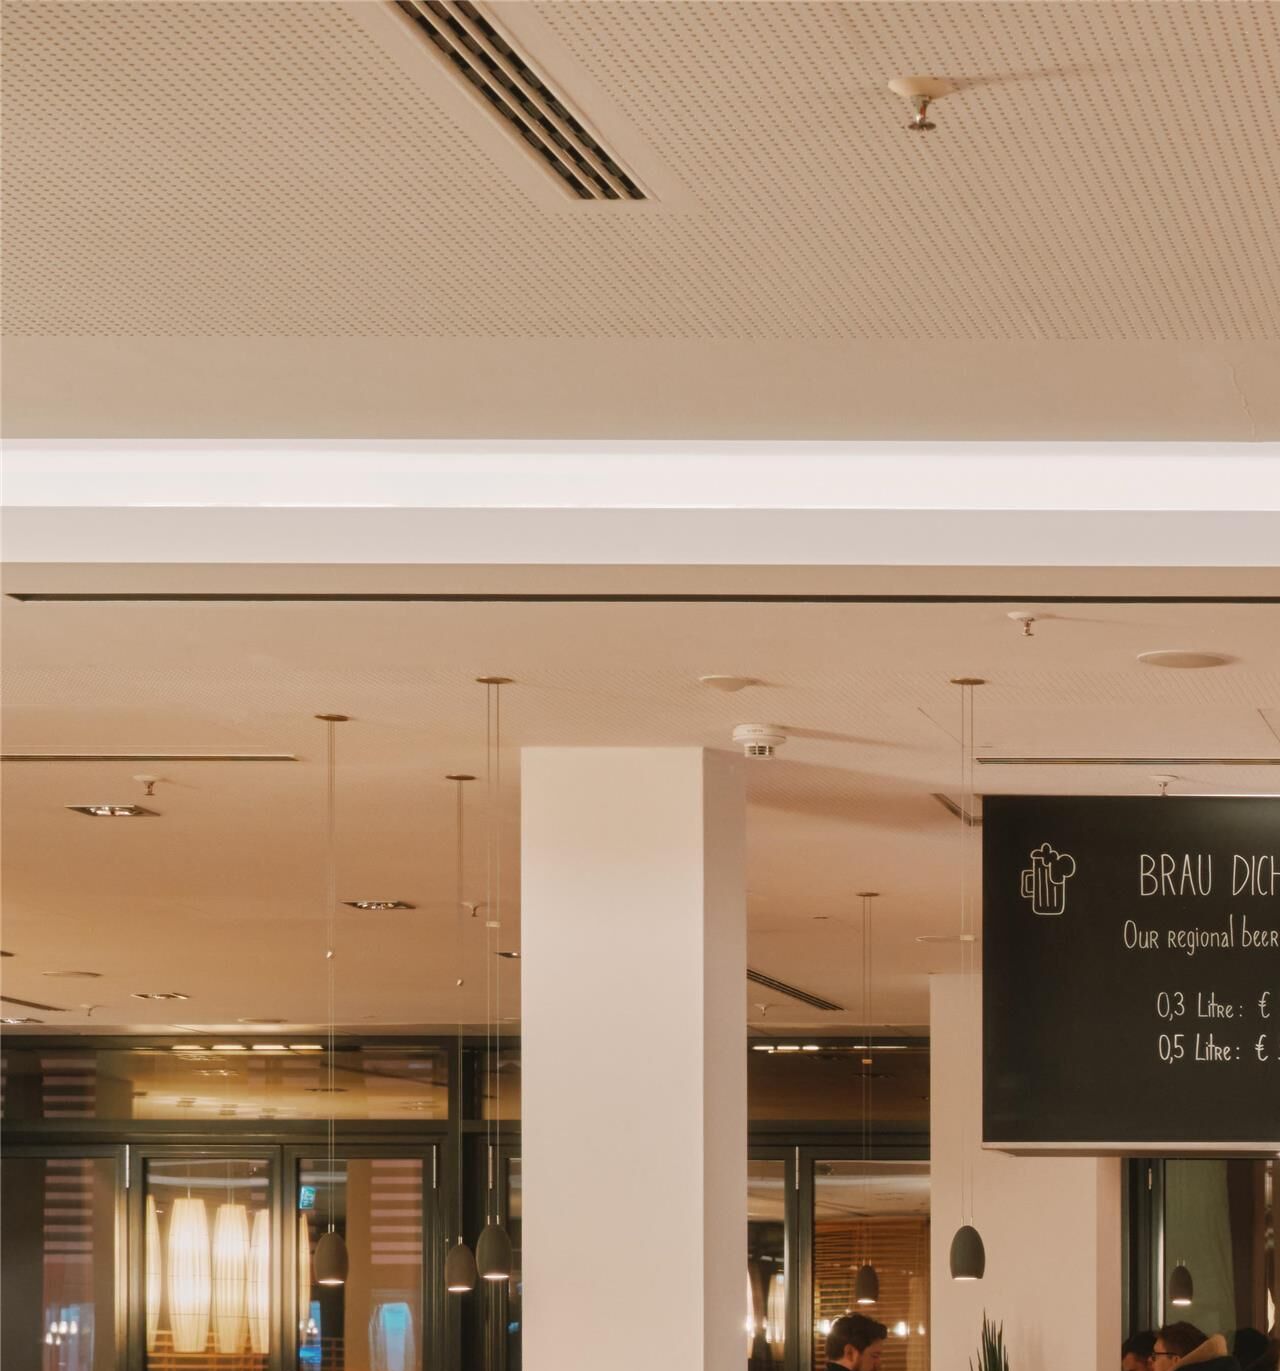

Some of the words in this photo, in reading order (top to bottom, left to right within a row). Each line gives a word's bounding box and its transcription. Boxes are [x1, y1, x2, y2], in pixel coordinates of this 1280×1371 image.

[1140, 853, 1212, 897] BRAU
[1123, 919, 1159, 949] Our
[1167, 913, 1234, 957] regional
[1156, 991, 1185, 1022] 0,3
[1158, 1033, 1185, 1065] 0,5
